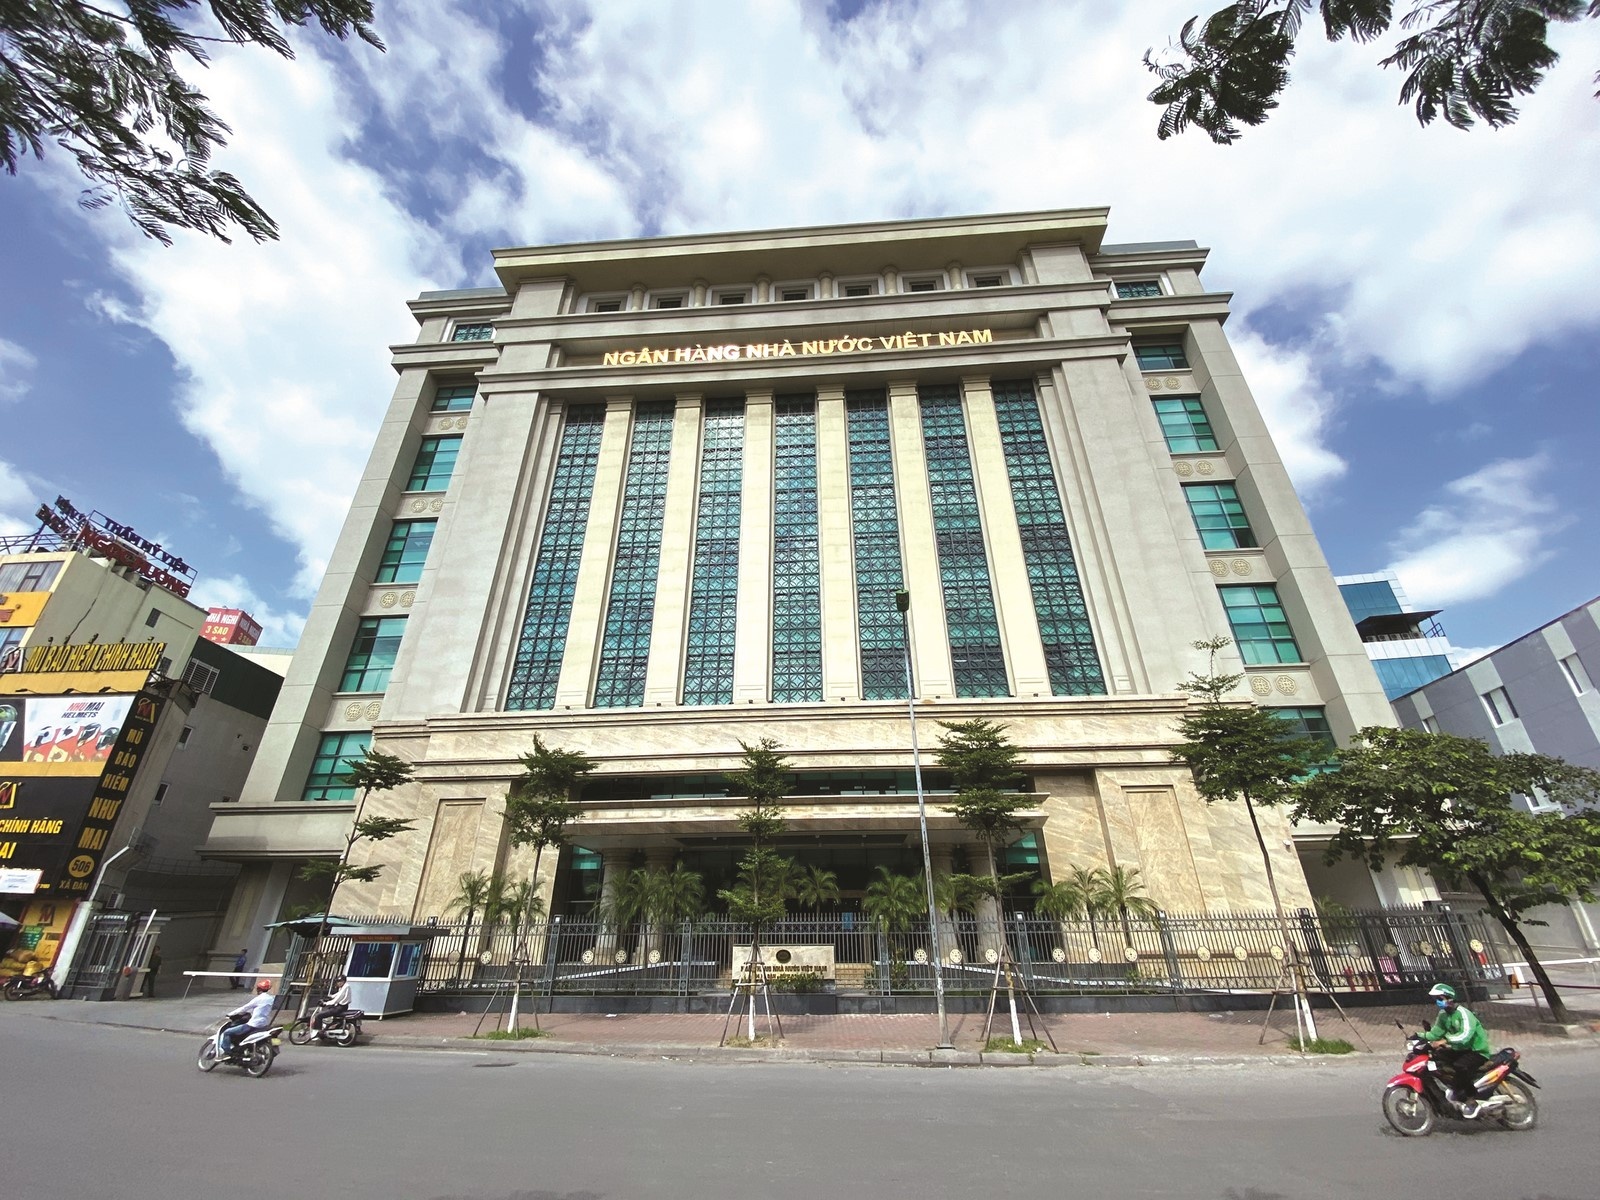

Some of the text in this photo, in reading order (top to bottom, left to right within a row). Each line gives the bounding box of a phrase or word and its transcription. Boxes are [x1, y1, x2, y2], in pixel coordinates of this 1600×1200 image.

[603, 347, 669, 366] NGÂN
[674, 343, 741, 362] HÀNG
[746, 339, 796, 359] NHÀ
[802, 335, 873, 355] NƯỚC
[939, 329, 993, 346] NAM
[205, 626, 229, 635] 3 SAO
[84, 702, 105, 711] MAI
[126, 728, 144, 745] MŨ
[115, 748, 137, 768] BẢO
[102, 770, 129, 791] HIỂM
[88, 796, 122, 820] NHƯ
[29, 816, 63, 834] HÃNG
[78, 827, 108, 850] MAI
[0, 841, 17, 859] AI
[72, 860, 91, 873] 506
